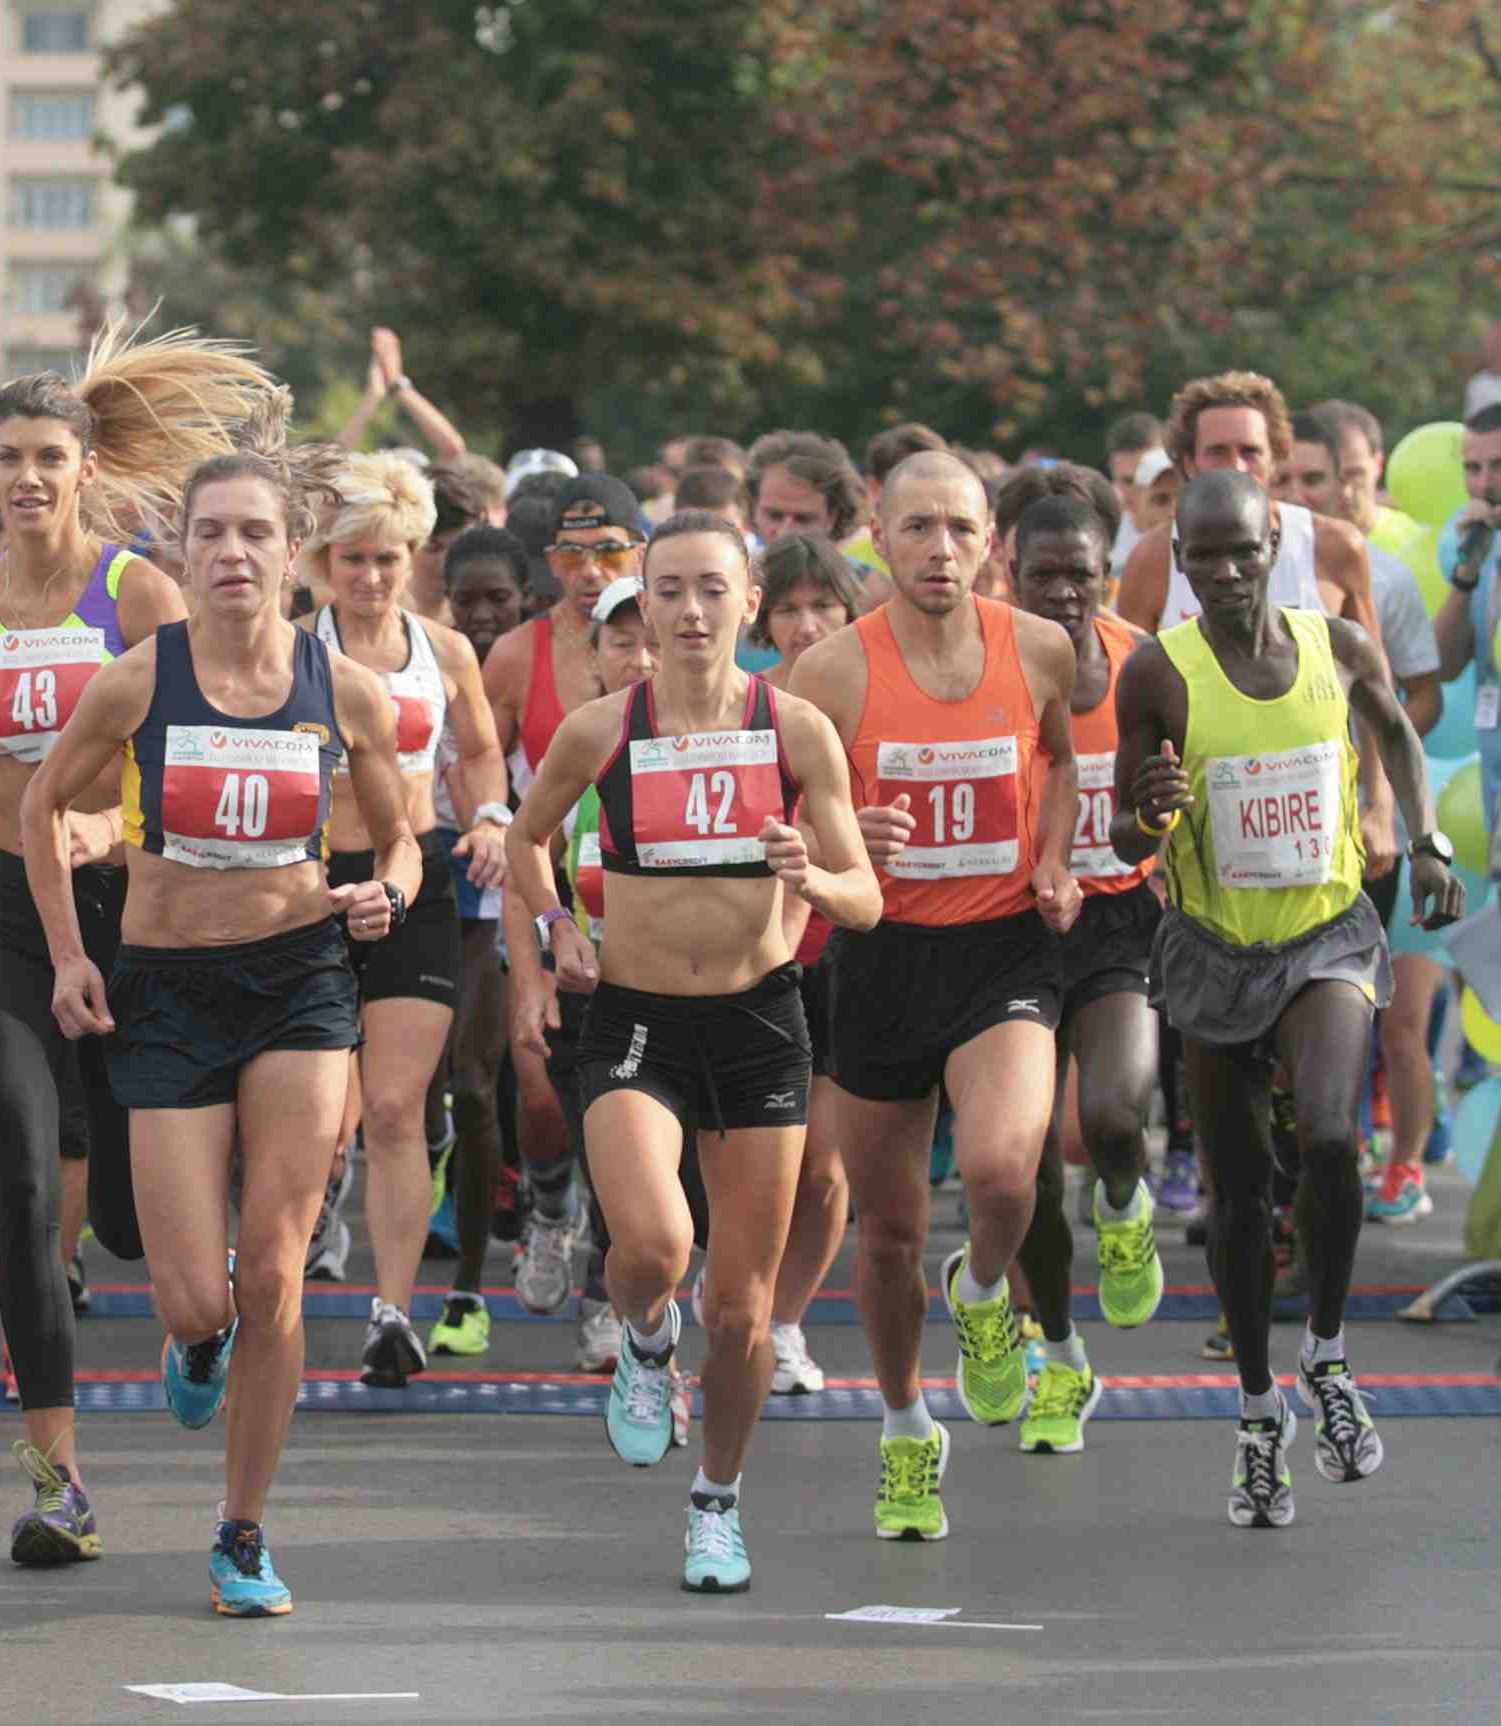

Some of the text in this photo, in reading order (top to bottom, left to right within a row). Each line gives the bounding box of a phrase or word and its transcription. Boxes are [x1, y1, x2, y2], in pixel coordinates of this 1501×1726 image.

[23, 636, 99, 648] VIVACOM
[12, 670, 57, 730] 43
[692, 734, 771, 747] VIVACOM
[938, 745, 1012, 761] VIVACOM
[215, 773, 269, 838] 40
[685, 770, 738, 835] 42
[928, 782, 975, 843] 19
[1074, 790, 1112, 844] 20
[1239, 789, 1322, 839] KIBIRE
